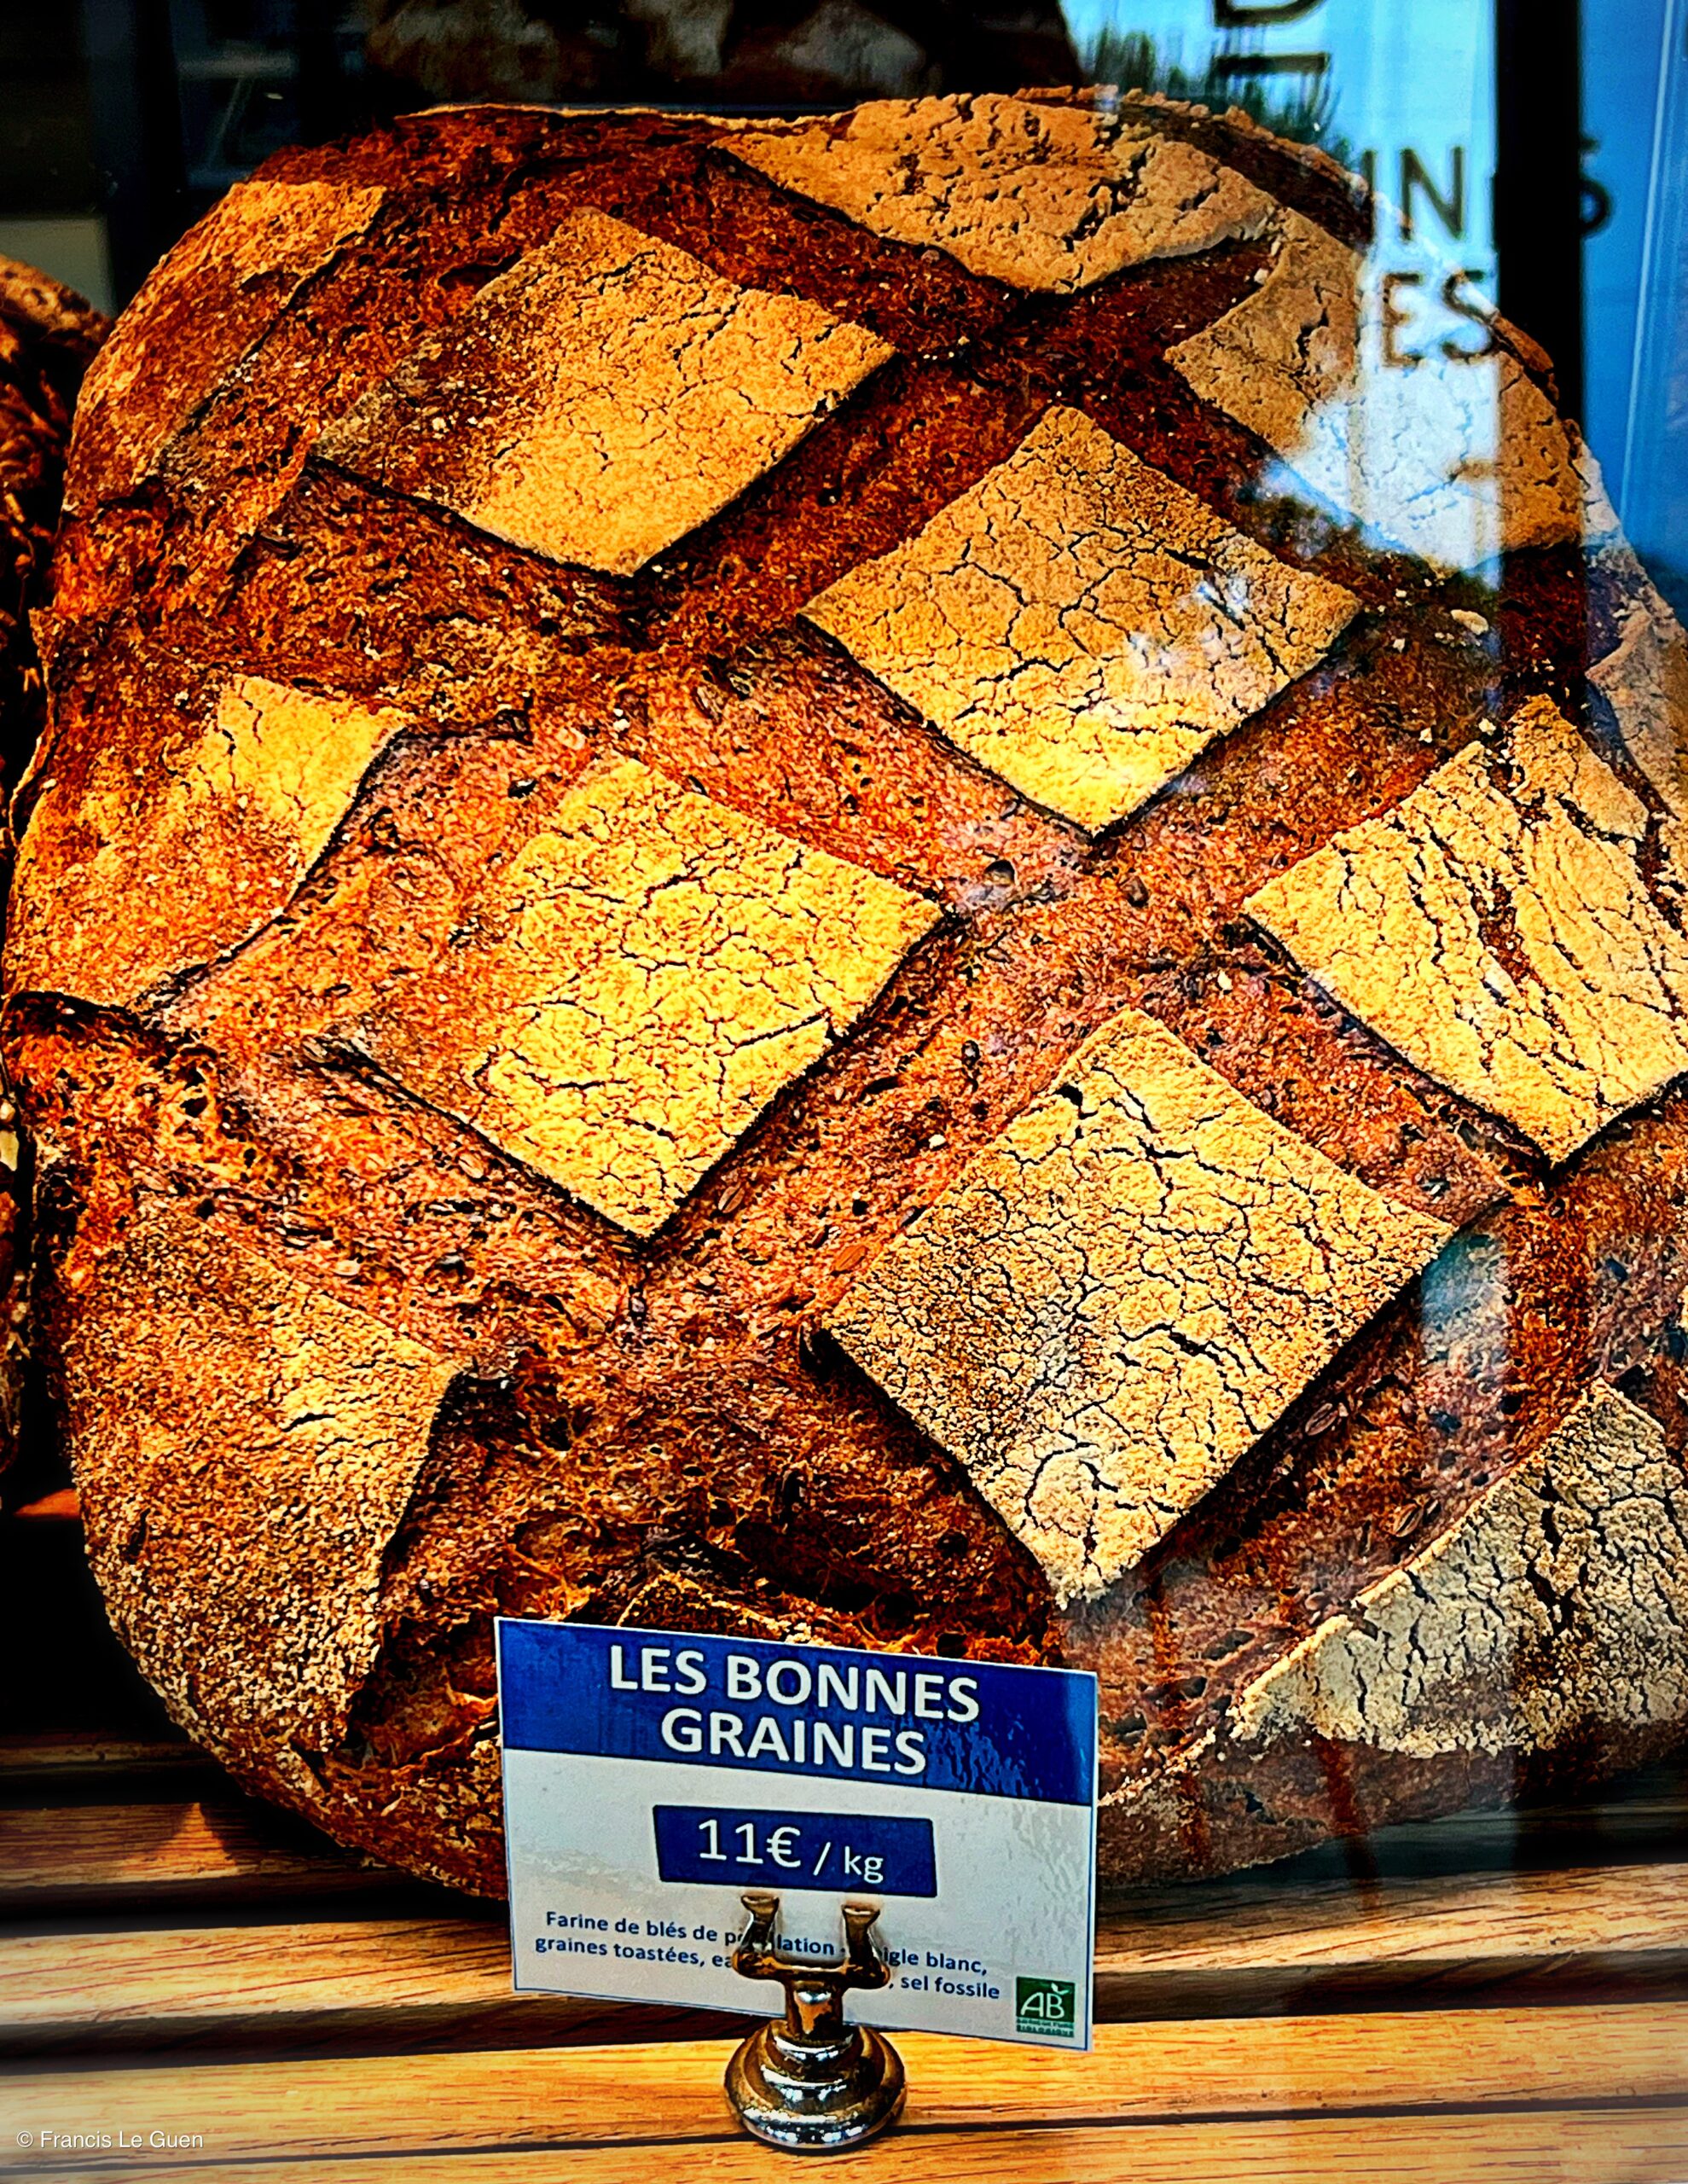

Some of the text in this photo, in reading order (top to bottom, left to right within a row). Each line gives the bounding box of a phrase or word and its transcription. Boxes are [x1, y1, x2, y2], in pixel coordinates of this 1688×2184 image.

[610, 1644, 980, 1723] LES BONNES
[660, 1707, 927, 1775] GRAINES
[698, 1819, 801, 1868] 11€
[844, 1845, 885, 1885] kg
[535, 1937, 608, 1956] graines
[613, 1943, 705, 1967] toastées,
[900, 1975, 930, 1992] sel
[934, 1976, 1001, 2000] fossile
[546, 1911, 988, 1977] Farine de blés de plation igle blanc,
[1020, 1991, 1065, 2019] AB
